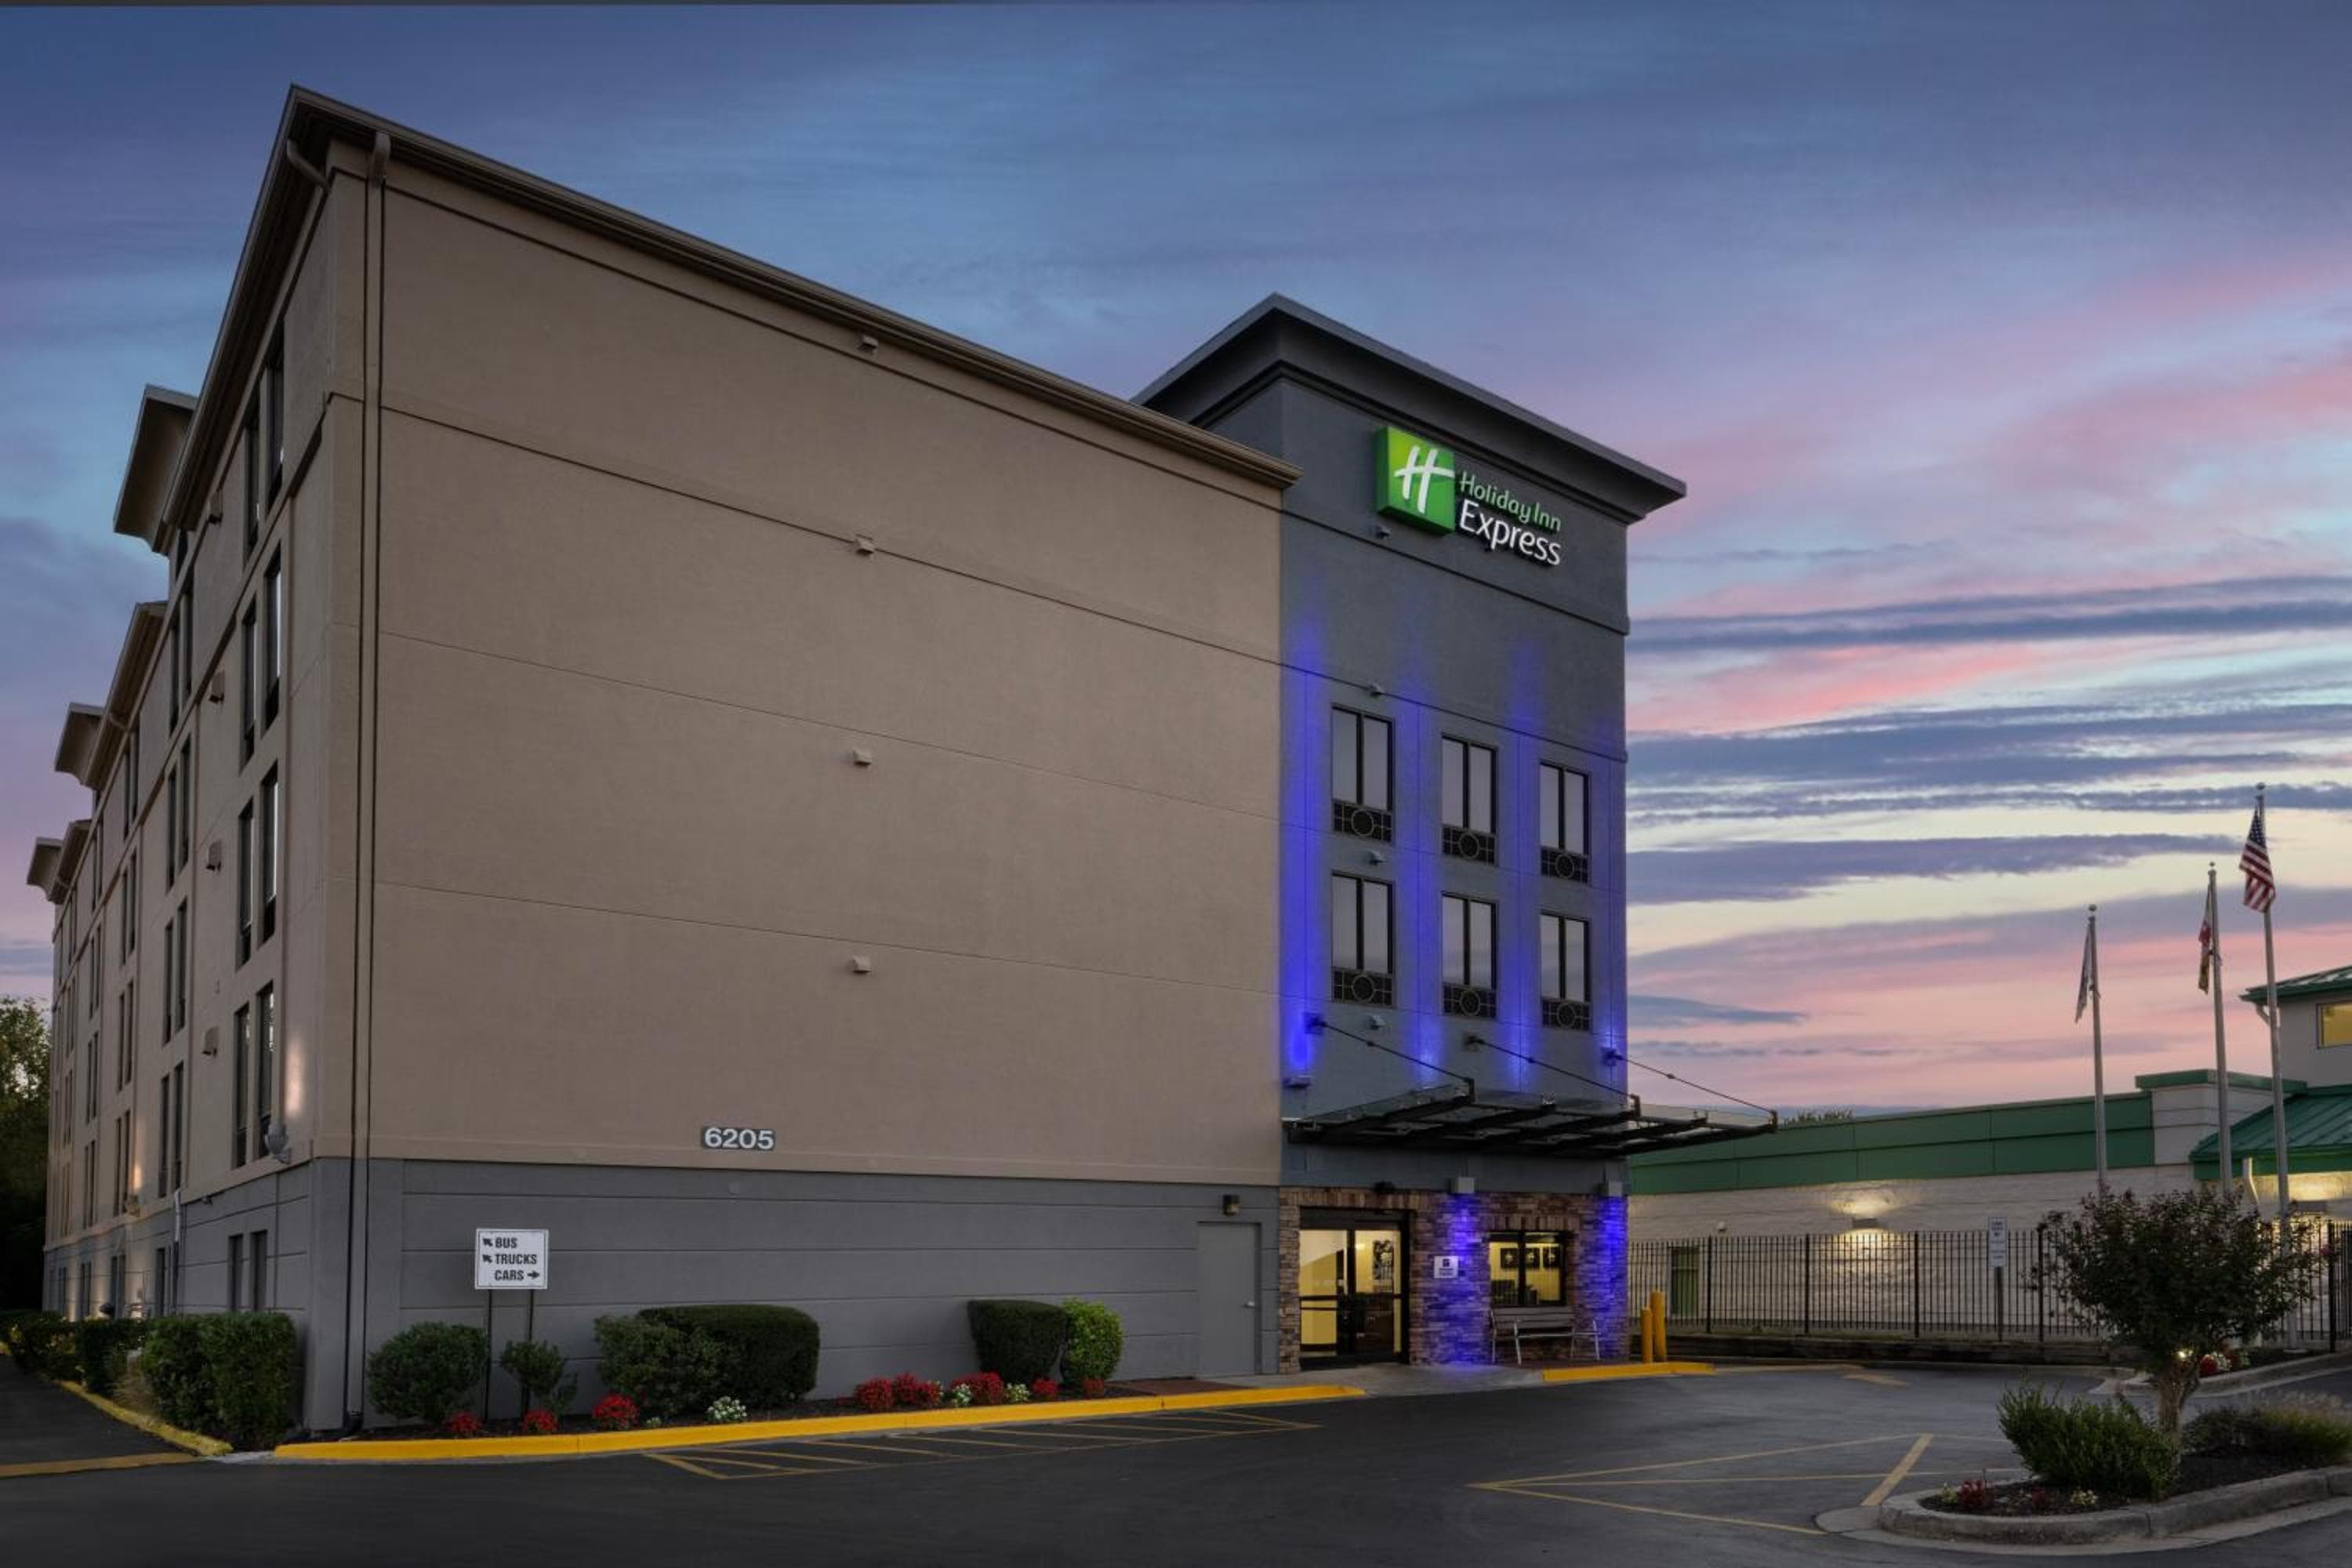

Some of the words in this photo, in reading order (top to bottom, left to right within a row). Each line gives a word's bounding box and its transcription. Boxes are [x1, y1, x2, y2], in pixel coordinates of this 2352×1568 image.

[1459, 470, 1531, 524] Holiday
[1534, 502, 1562, 532] Inn
[1459, 499, 1561, 565] Express
[705, 1127, 774, 1149] 6205
[495, 1237, 517, 1248] BUS
[495, 1254, 537, 1265] TRUCKS
[495, 1269, 524, 1280] CARS
